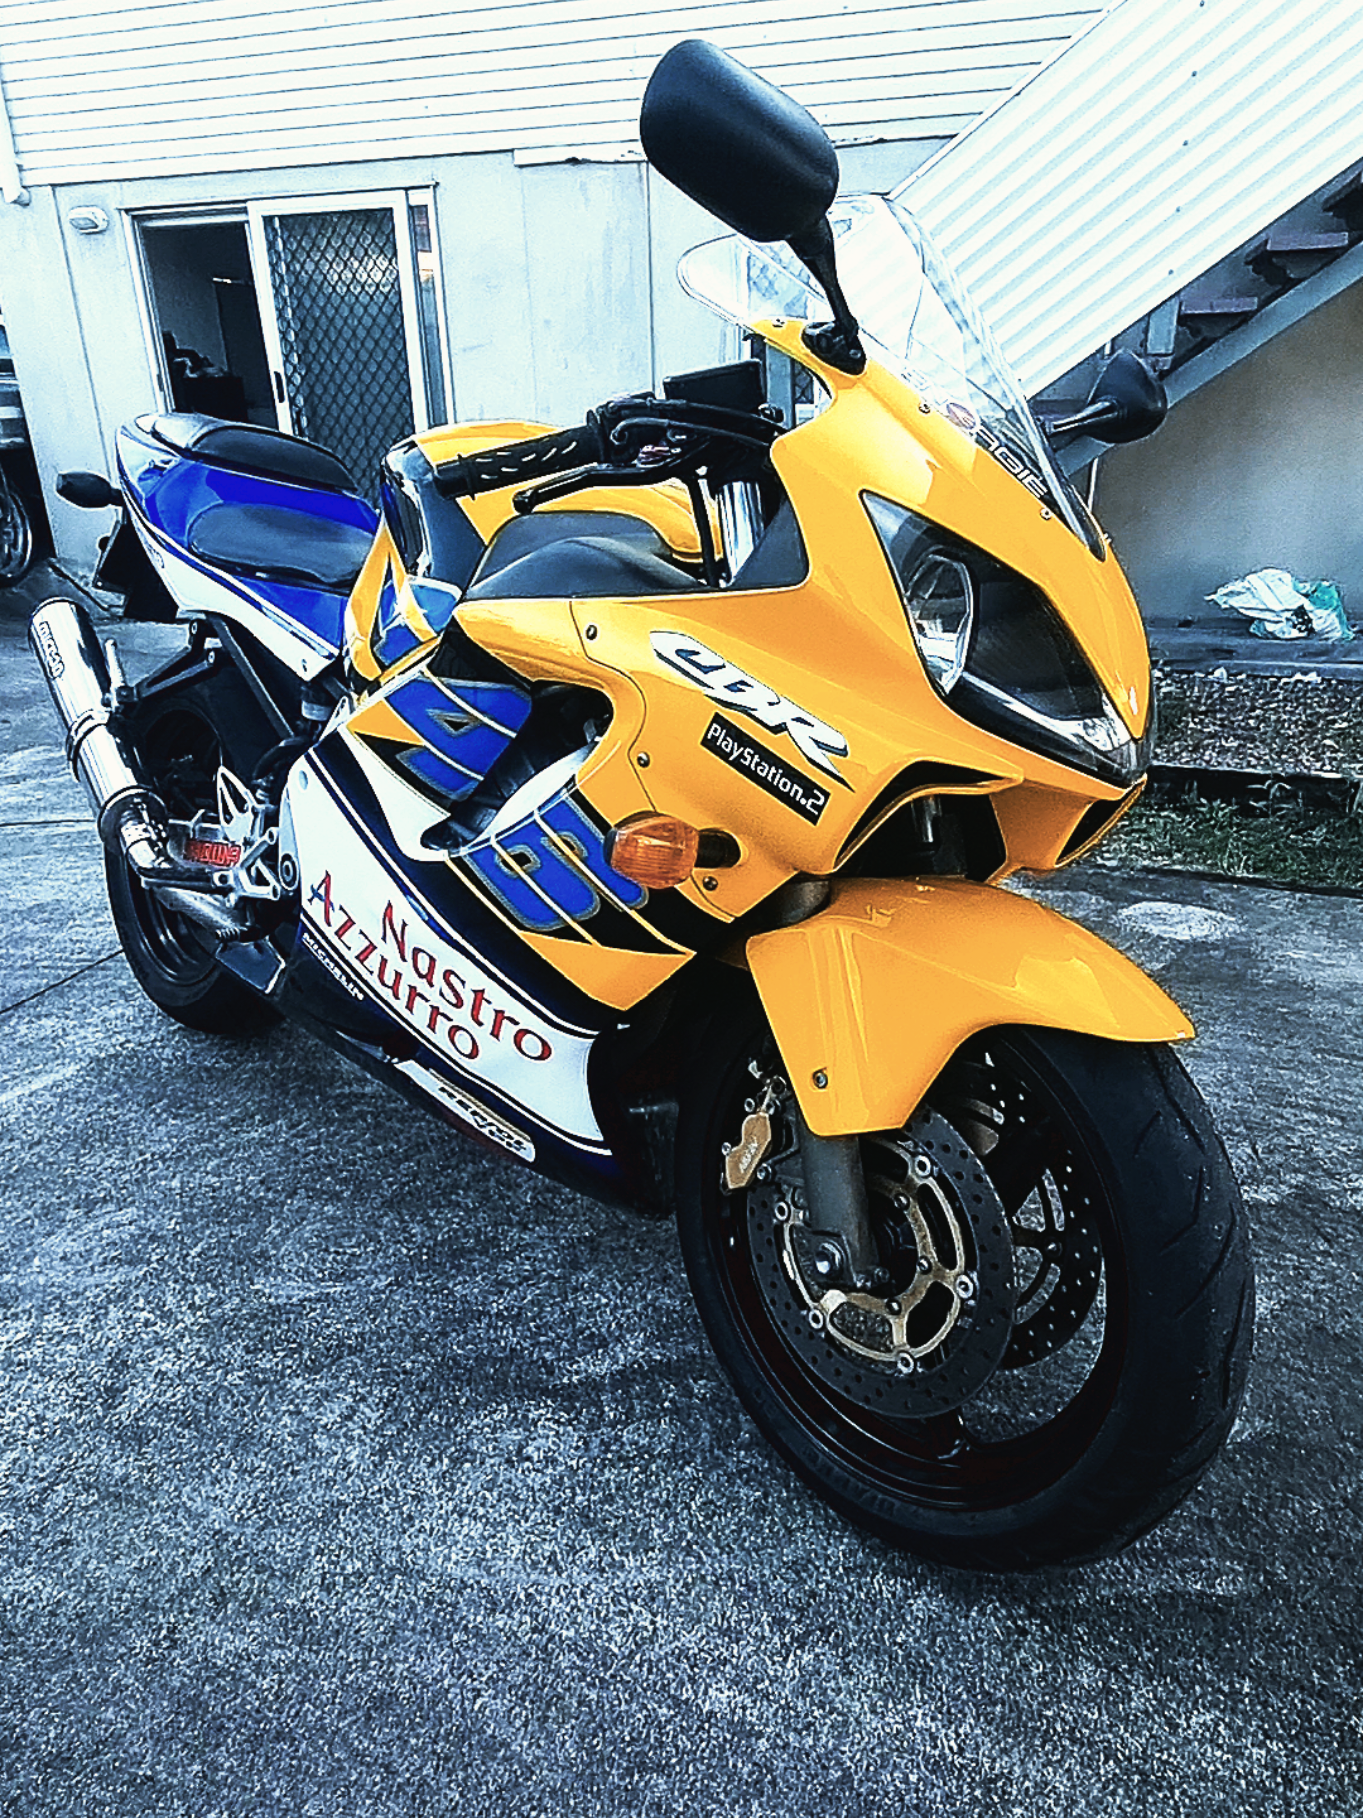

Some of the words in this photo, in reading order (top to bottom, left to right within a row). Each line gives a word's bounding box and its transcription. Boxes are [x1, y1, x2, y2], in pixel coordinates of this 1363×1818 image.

[649, 630, 856, 793] CBR
[307, 869, 480, 1061] Azzurro
[380, 899, 553, 1062] Nastro
